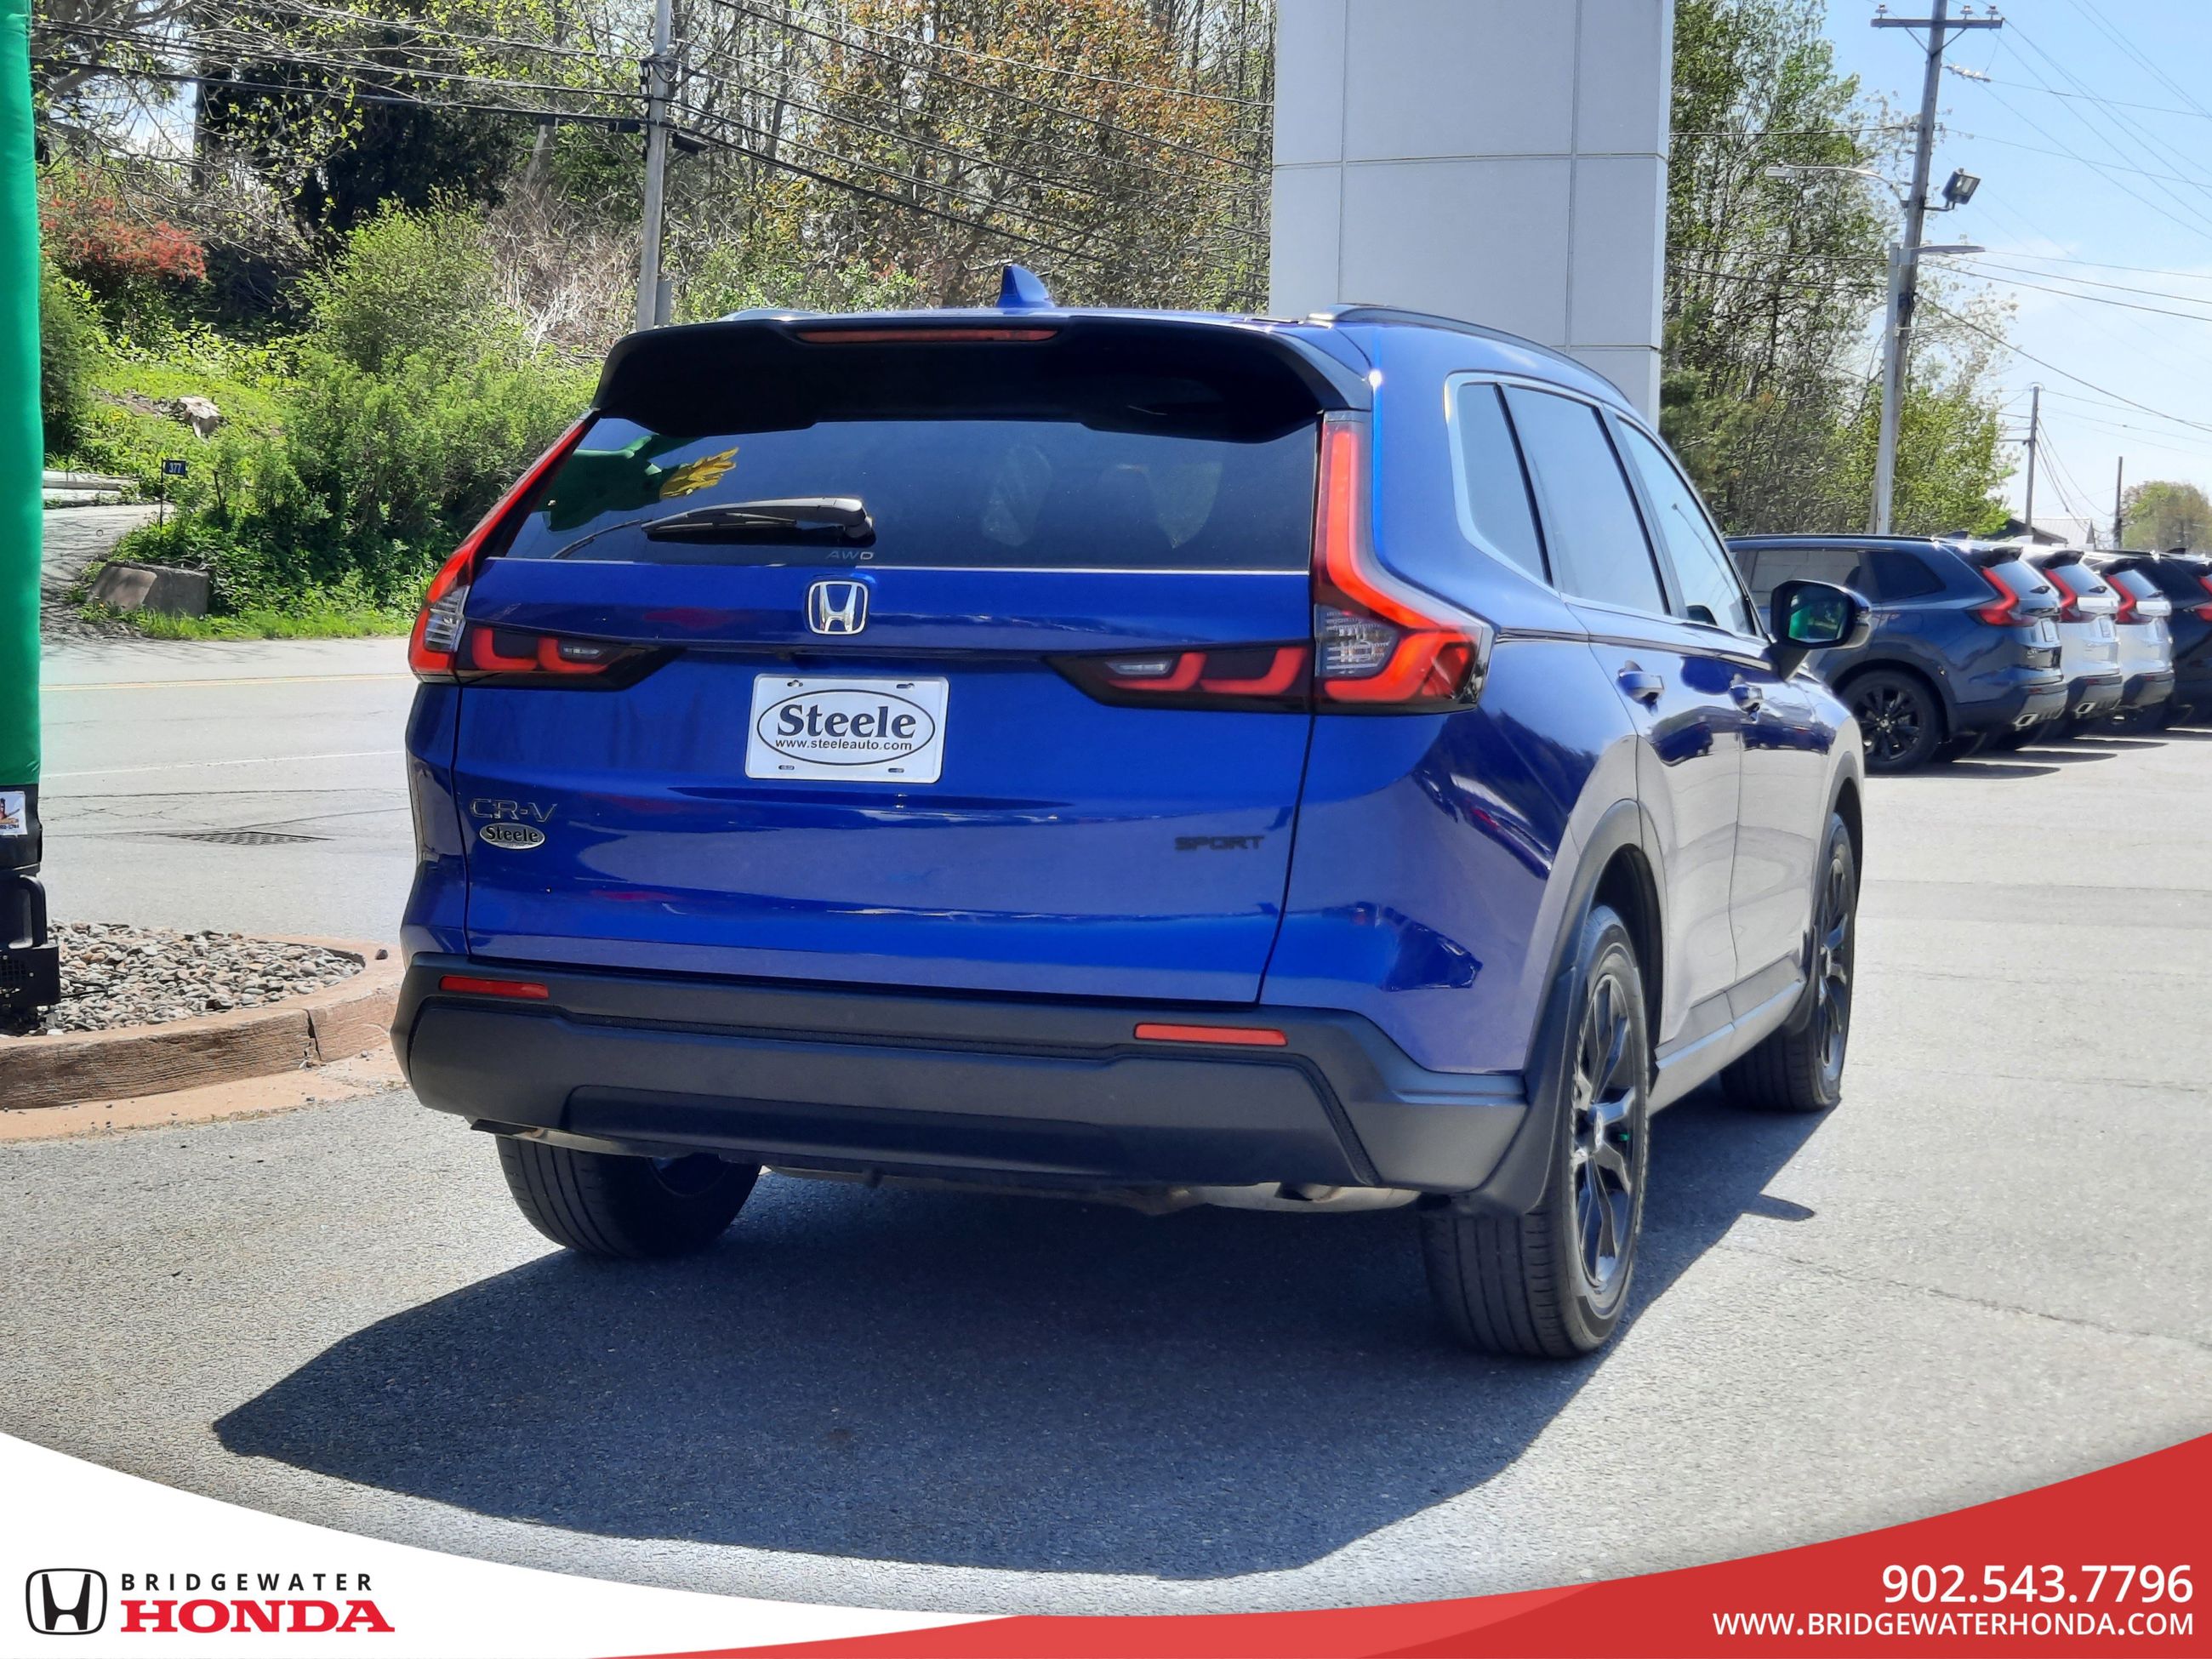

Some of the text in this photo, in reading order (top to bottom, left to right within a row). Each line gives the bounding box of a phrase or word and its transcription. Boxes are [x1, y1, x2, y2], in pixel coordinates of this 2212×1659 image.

[168, 462, 183, 474] 377
[826, 551, 875, 561] AWD
[777, 704, 916, 739] Steele
[775, 738, 913, 751] www.steeleauto.com
[470, 798, 558, 823] CR-V
[486, 825, 539, 843] Steele
[1175, 835, 1265, 850] SPORT
